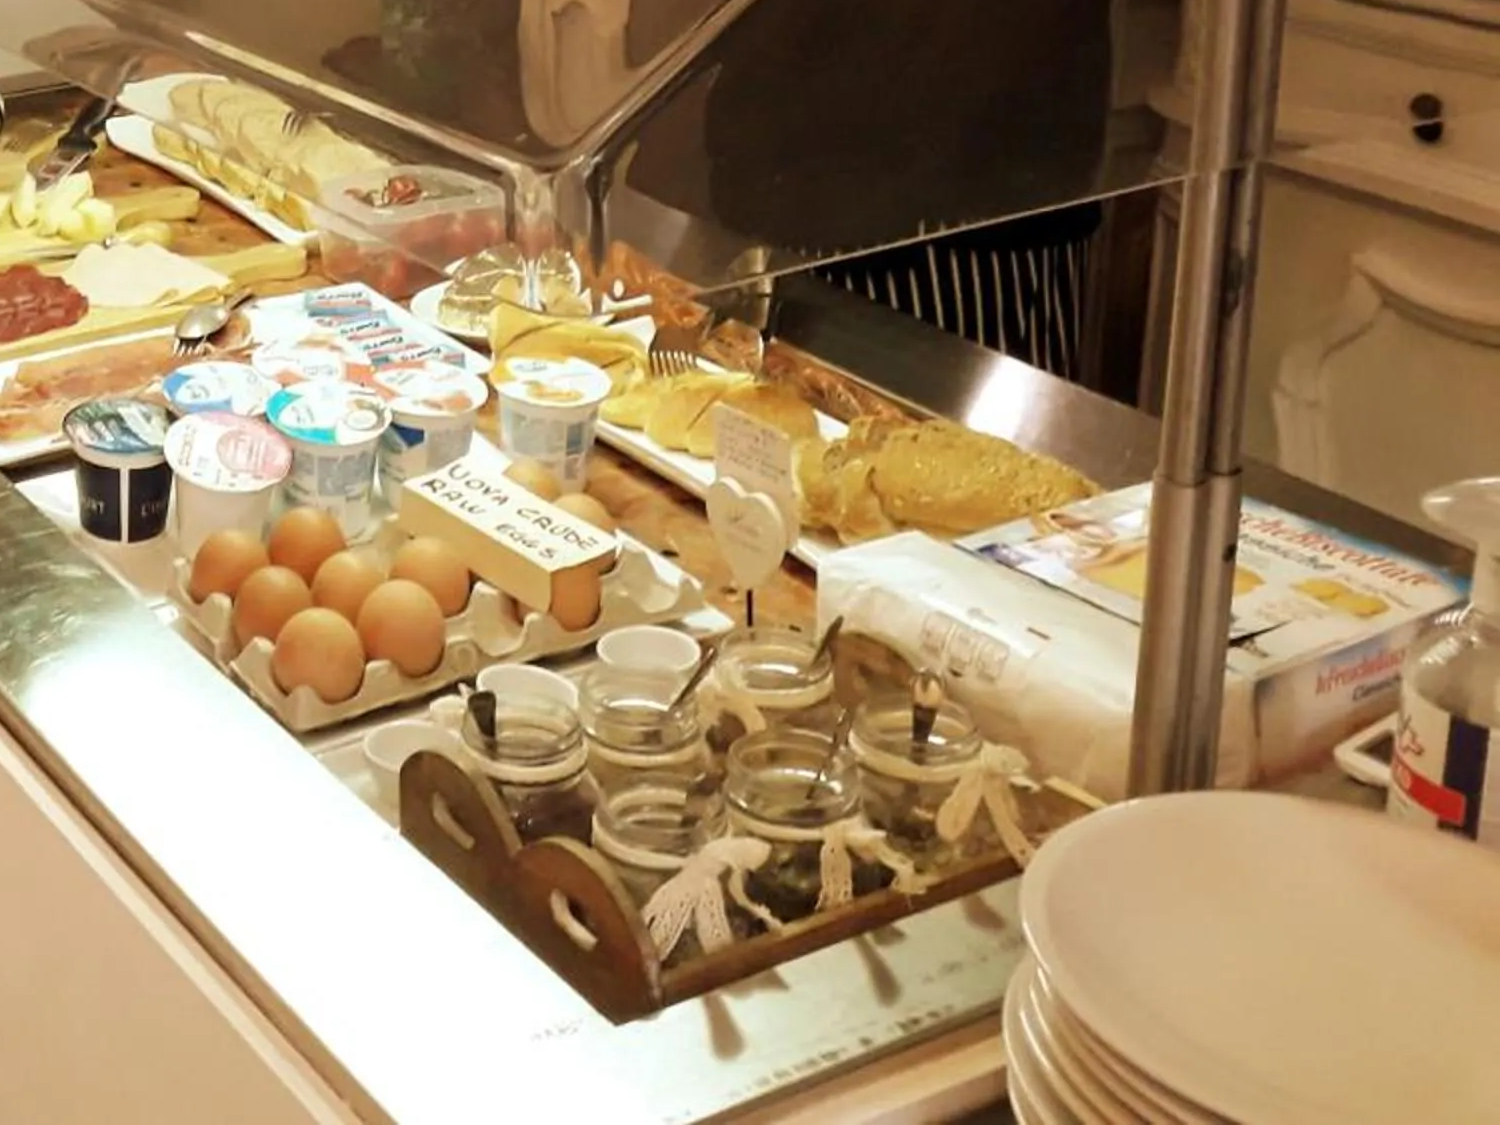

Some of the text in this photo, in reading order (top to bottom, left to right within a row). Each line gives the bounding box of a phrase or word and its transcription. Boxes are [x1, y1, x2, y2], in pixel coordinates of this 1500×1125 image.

[420, 477, 487, 515] RAW
[448, 463, 599, 551] UOVA CRUDE
